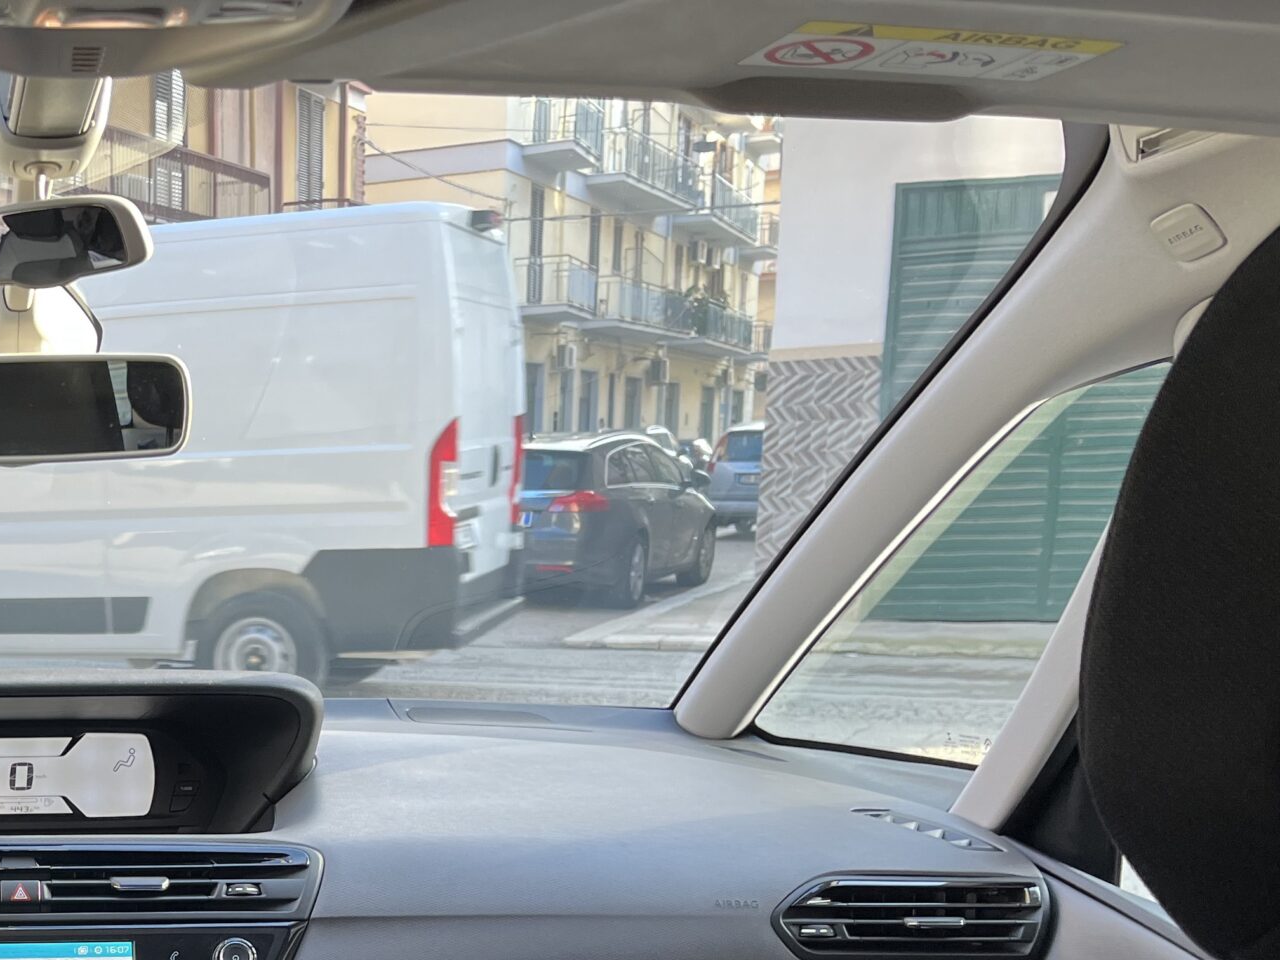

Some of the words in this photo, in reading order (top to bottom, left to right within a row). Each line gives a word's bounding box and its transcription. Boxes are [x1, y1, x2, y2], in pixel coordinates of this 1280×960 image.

[933, 32, 1082, 49] AIRBAG
[9, 762, 34, 791] 0
[714, 899, 760, 909] AIRBAG
